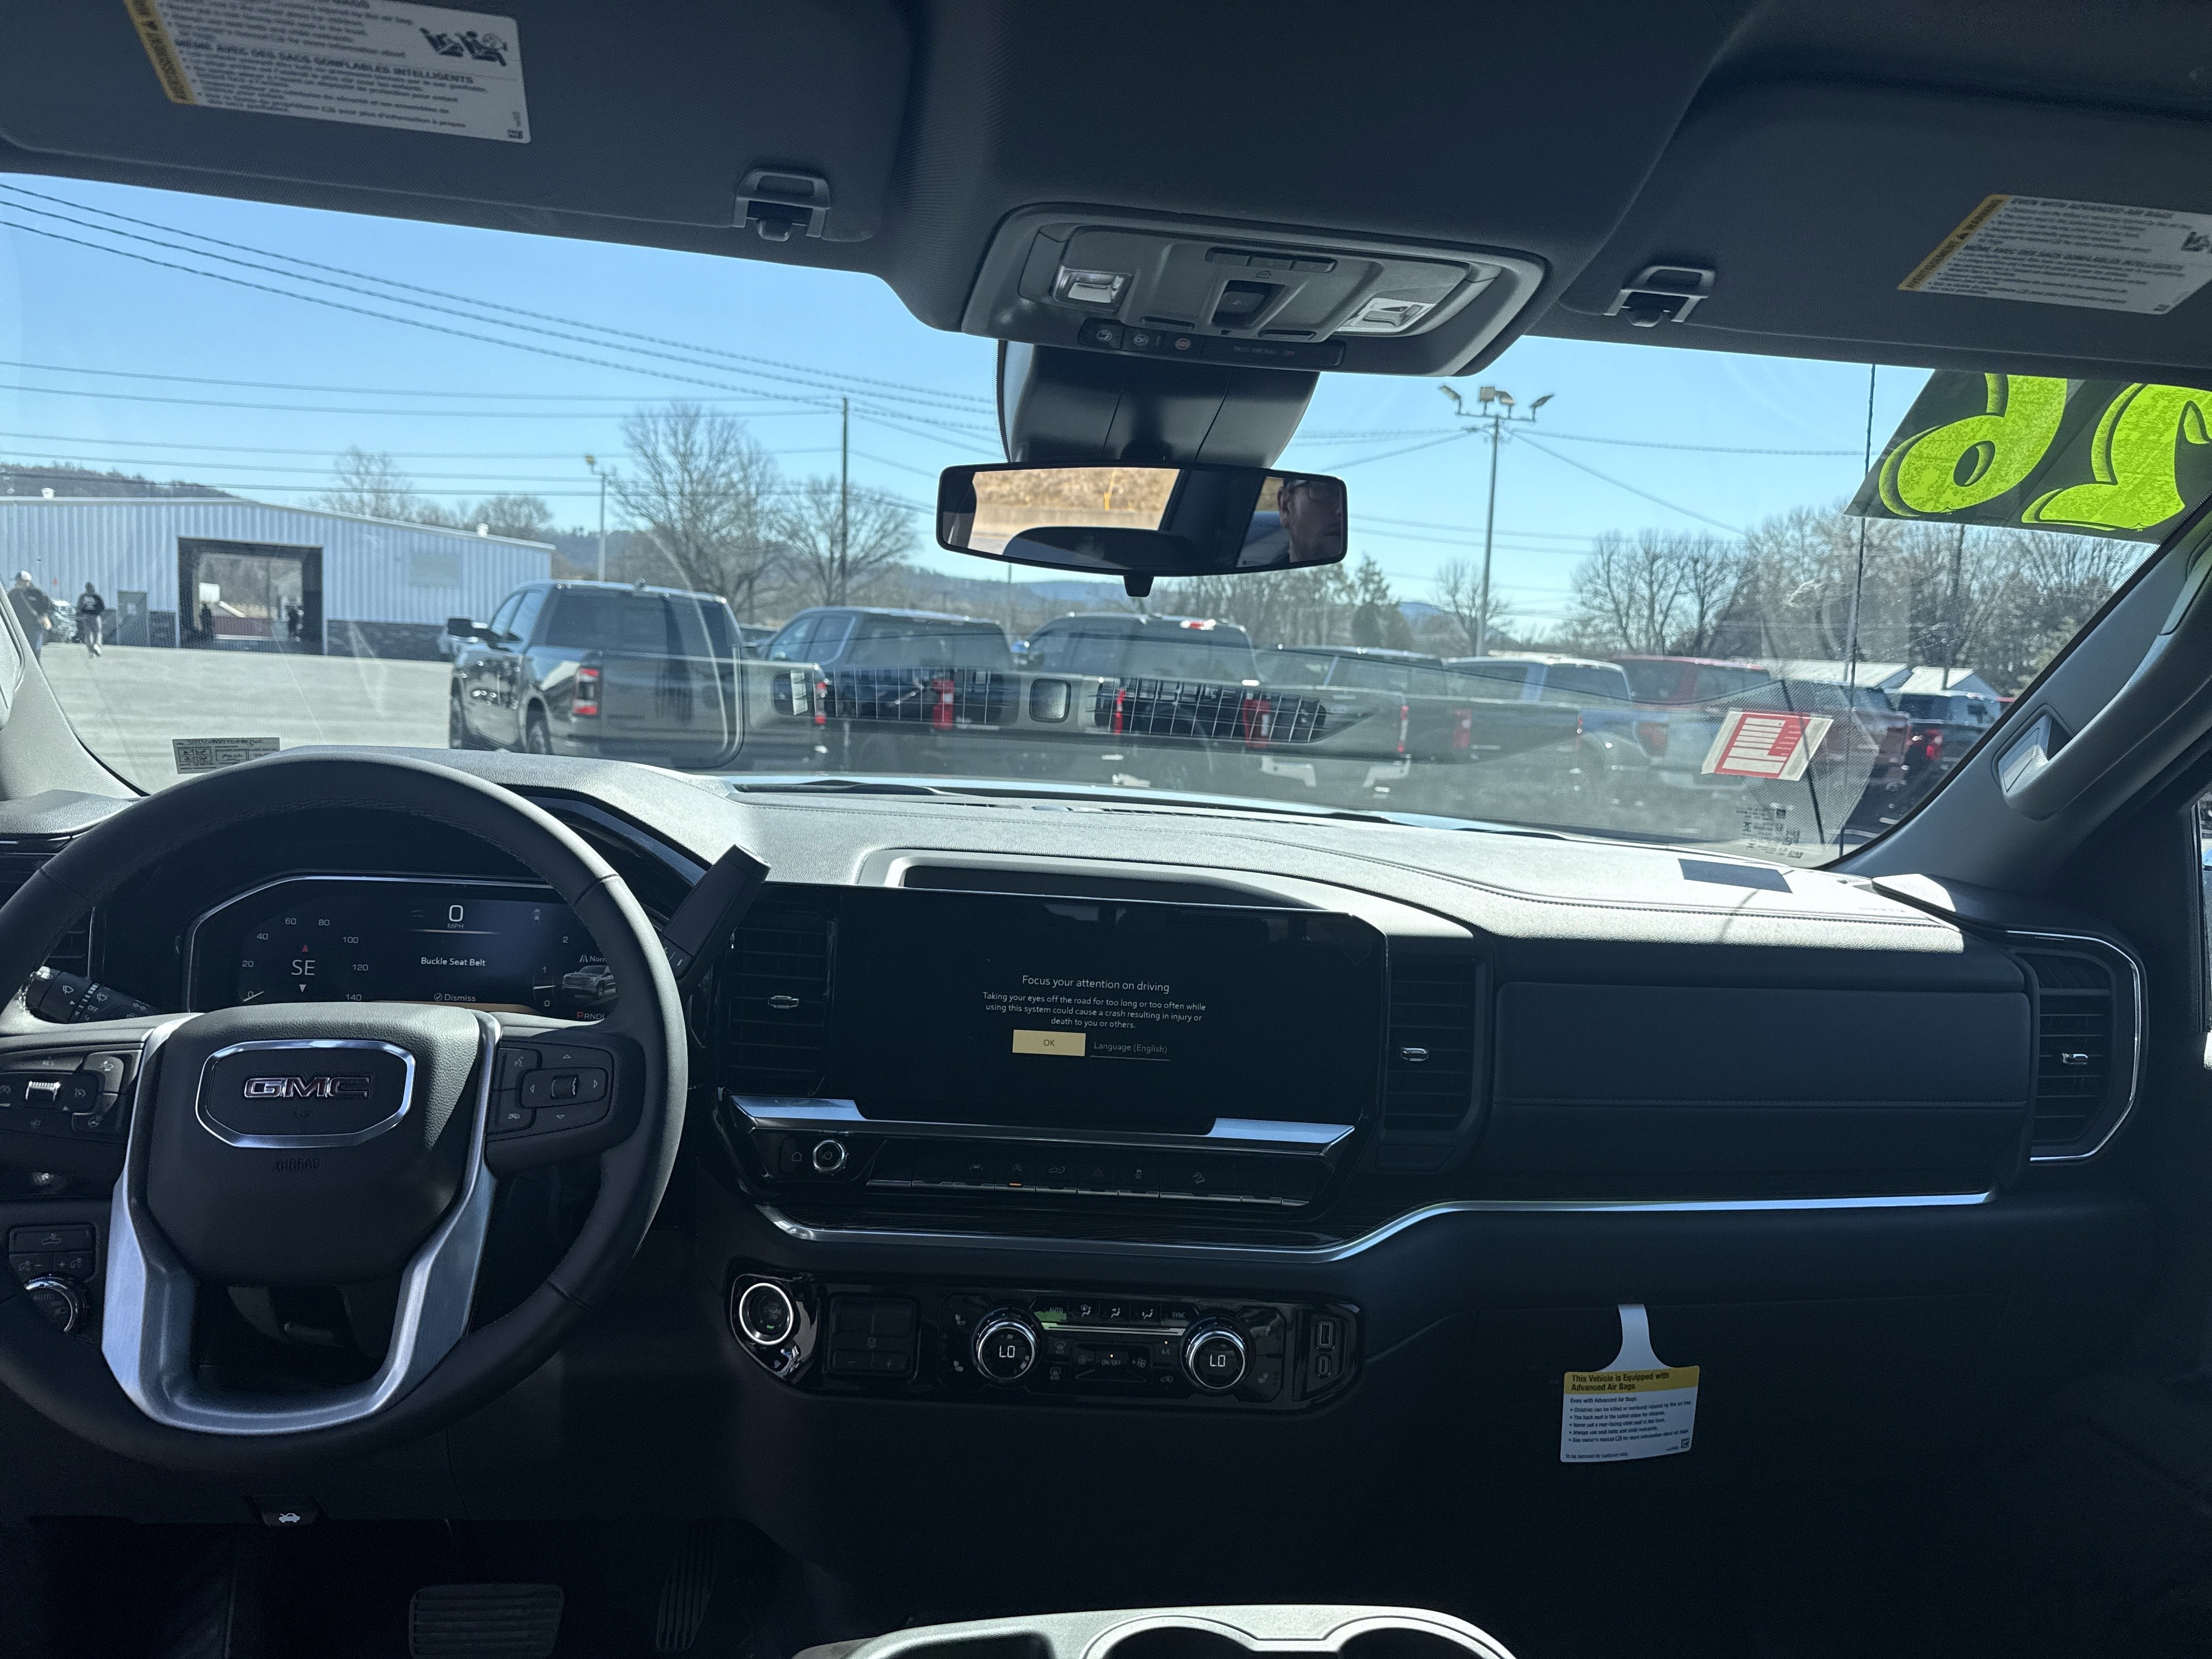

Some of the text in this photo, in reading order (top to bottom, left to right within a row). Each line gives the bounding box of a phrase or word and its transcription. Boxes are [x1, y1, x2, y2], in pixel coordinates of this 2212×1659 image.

[449, 905, 464, 922] 0
[291, 960, 316, 975] SE
[449, 958, 467, 966] Seat
[470, 958, 486, 967] Belt
[1023, 975, 1050, 985] Focus
[1052, 978, 1074, 989] your
[1076, 979, 1120, 990] attention
[1137, 981, 1170, 994] driving
[444, 994, 476, 1002] Dismiss
[983, 992, 1007, 1002] Taking
[1009, 995, 1026, 1003] your
[1028, 995, 1045, 1003] eyes
[1046, 995, 1059, 1003] off
[1059, 996, 1072, 1005] the
[1074, 997, 1091, 1005] road
[1120, 999, 1137, 1008] long
[1164, 1001, 1184, 1009] often
[1186, 1002, 1206, 1011] while
[87, 1005, 99, 1013] OFF
[986, 1004, 1006, 1013] using
[1024, 1006, 1051, 1014] system
[1053, 1007, 1073, 1015] could
[1105, 1009, 1125, 1017] crash
[1127, 1010, 1160, 1020] resulting
[1171, 1012, 1192, 1022] injury
[1109, 1021, 1136, 1029] others.
[1094, 1042, 1167, 1053] Language (English)
[244, 1076, 371, 1099] GMC
[999, 1345, 1015, 1358] LO
[1210, 1354, 1226, 1367] LO
[1623, 1374, 1654, 1384] Equipped
[1619, 1383, 1635, 1391] Bags
